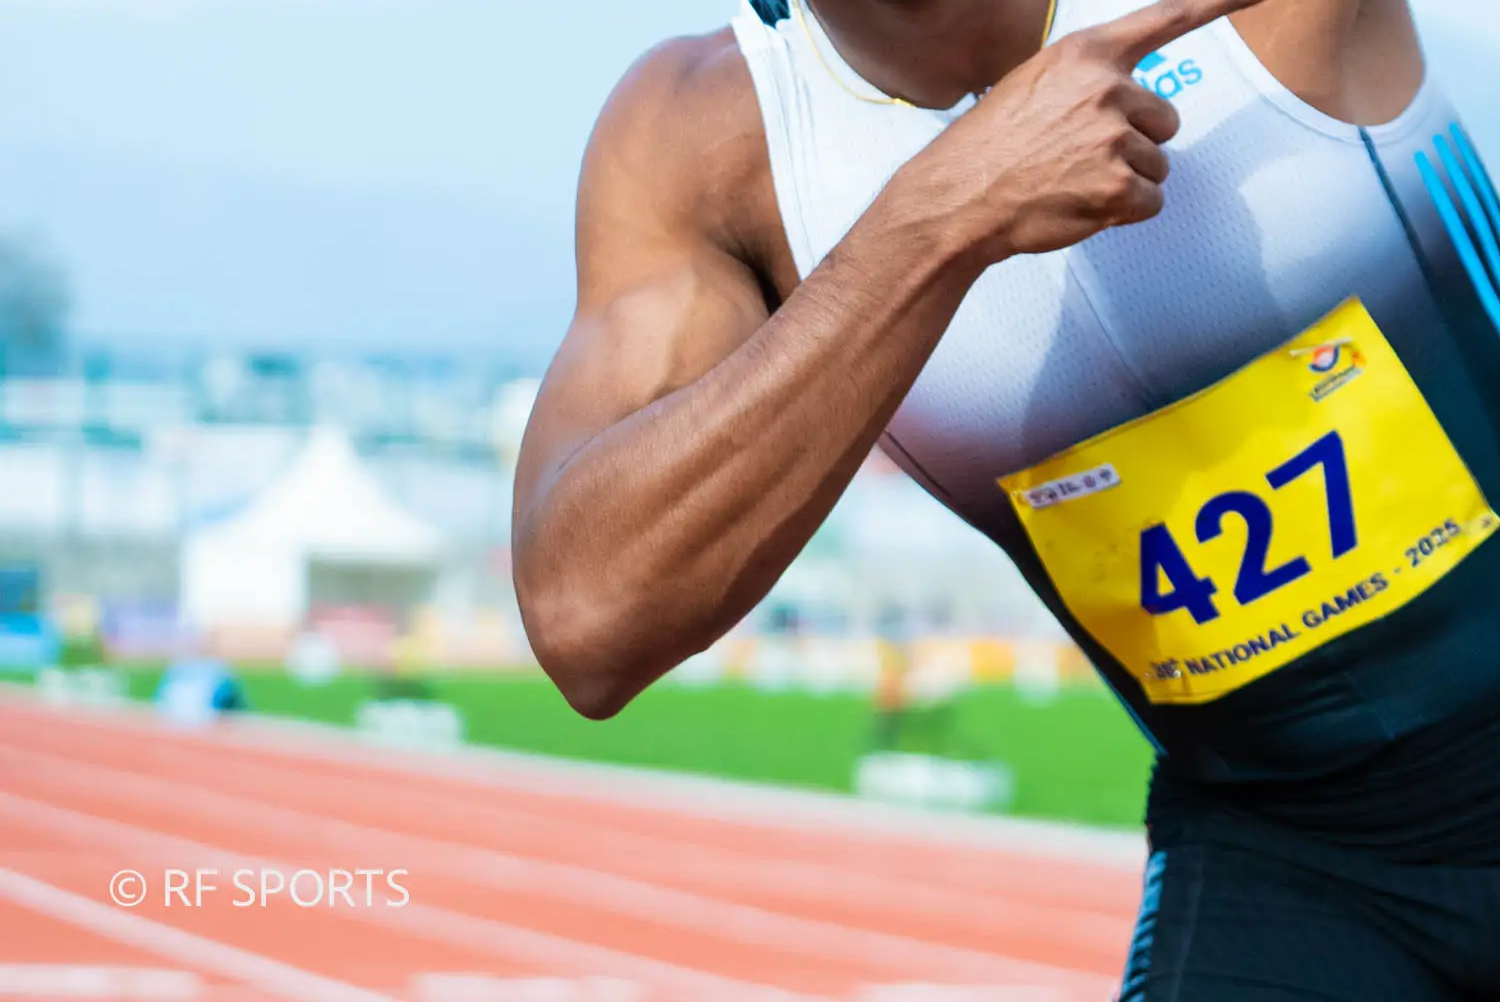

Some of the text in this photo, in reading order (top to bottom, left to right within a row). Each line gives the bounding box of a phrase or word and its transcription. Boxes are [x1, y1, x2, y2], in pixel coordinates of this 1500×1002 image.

[1140, 430, 1357, 623] 427
[1187, 623, 1300, 675] NATIONAL
[1302, 572, 1389, 629] GAMES
[1404, 518, 1461, 568] 2025
